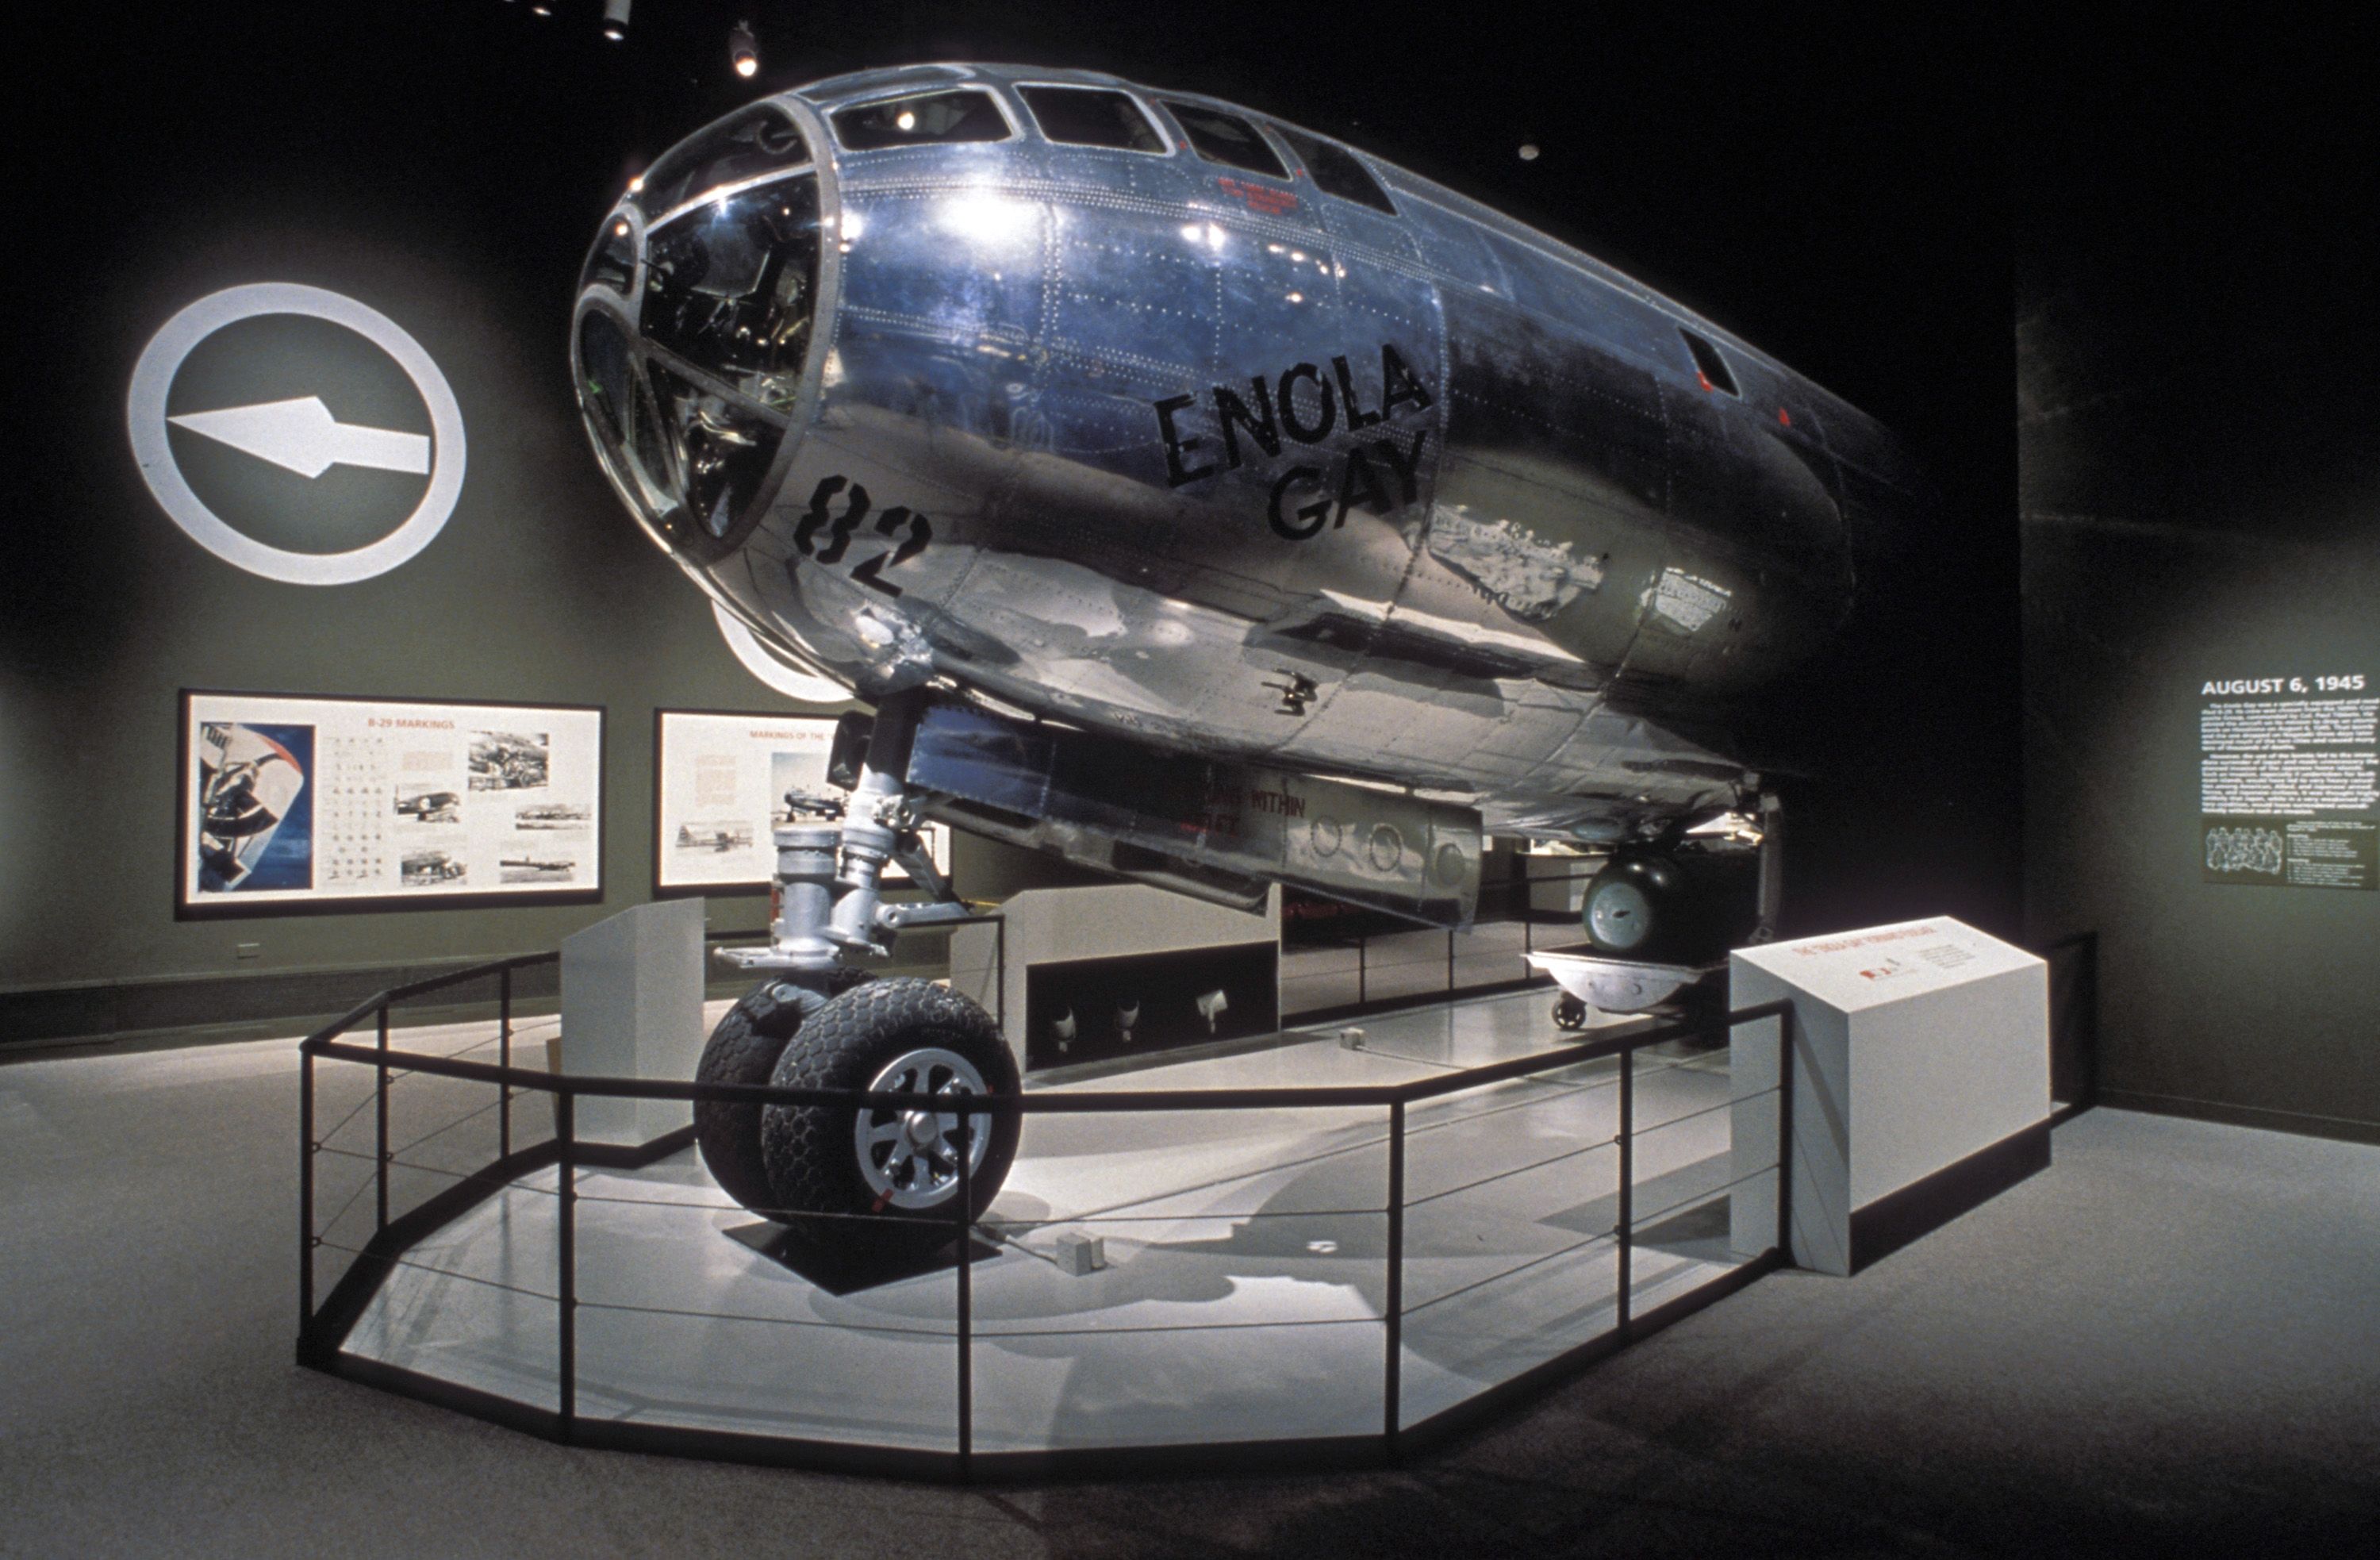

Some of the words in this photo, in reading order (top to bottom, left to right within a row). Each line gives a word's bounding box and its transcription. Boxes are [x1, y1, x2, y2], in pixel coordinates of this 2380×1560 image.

[1154, 344, 1434, 488] ENOLA
[1268, 430, 1426, 540] GAY
[795, 475, 933, 597] 82
[2201, 678, 2284, 695] AUGUST
[2289, 677, 2309, 694] 6,
[2315, 674, 2365, 690] 1945
[367, 717, 393, 728] B-29
[396, 718, 455, 729] MARKINGS
[748, 731, 794, 740] MARKINGS
[796, 732, 807, 740] OF
[1250, 789, 1306, 818] WITHIN
